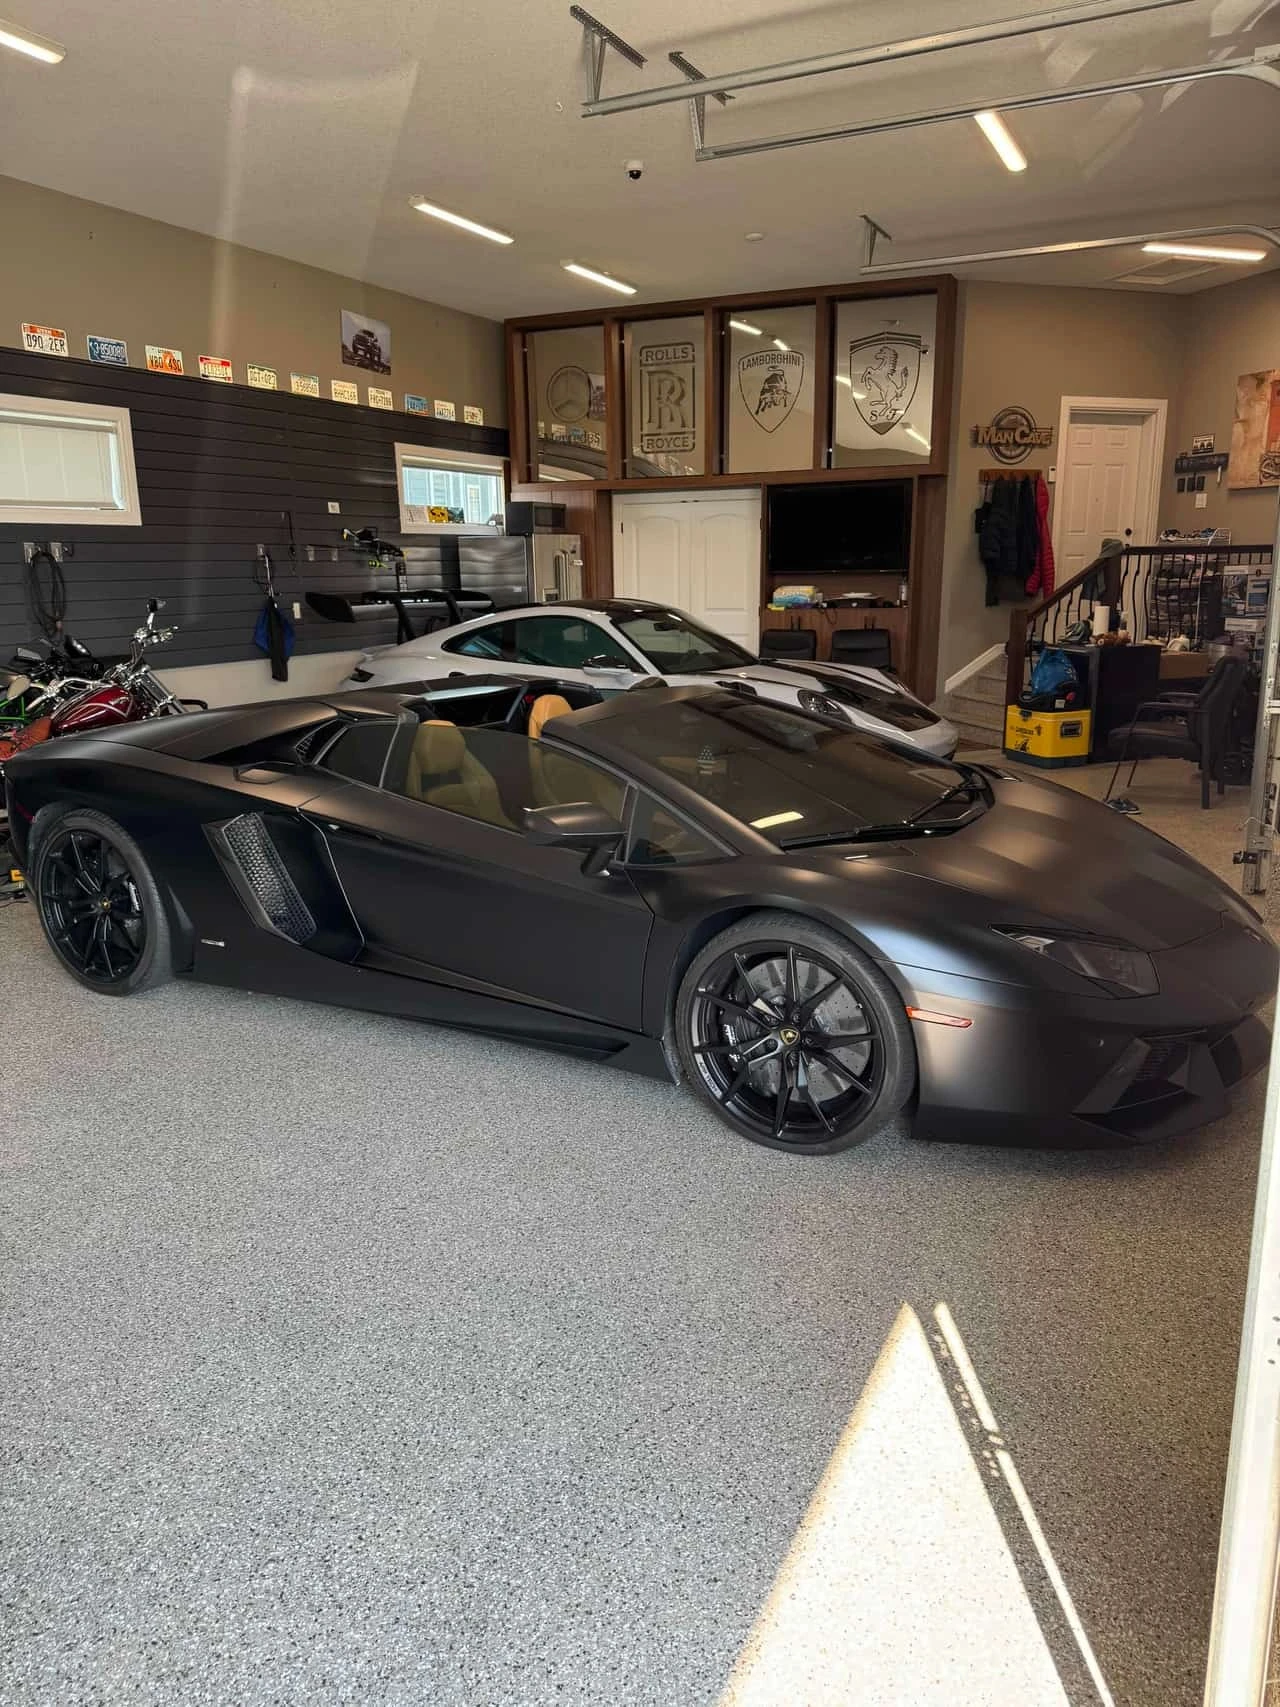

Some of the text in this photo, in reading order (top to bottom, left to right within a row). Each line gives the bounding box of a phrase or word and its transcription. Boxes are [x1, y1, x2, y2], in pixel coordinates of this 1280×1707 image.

[645, 347, 689, 361] ROLLS
[742, 353, 800, 371] LAMBORGHINI
[646, 436, 690, 449] ROYCE
